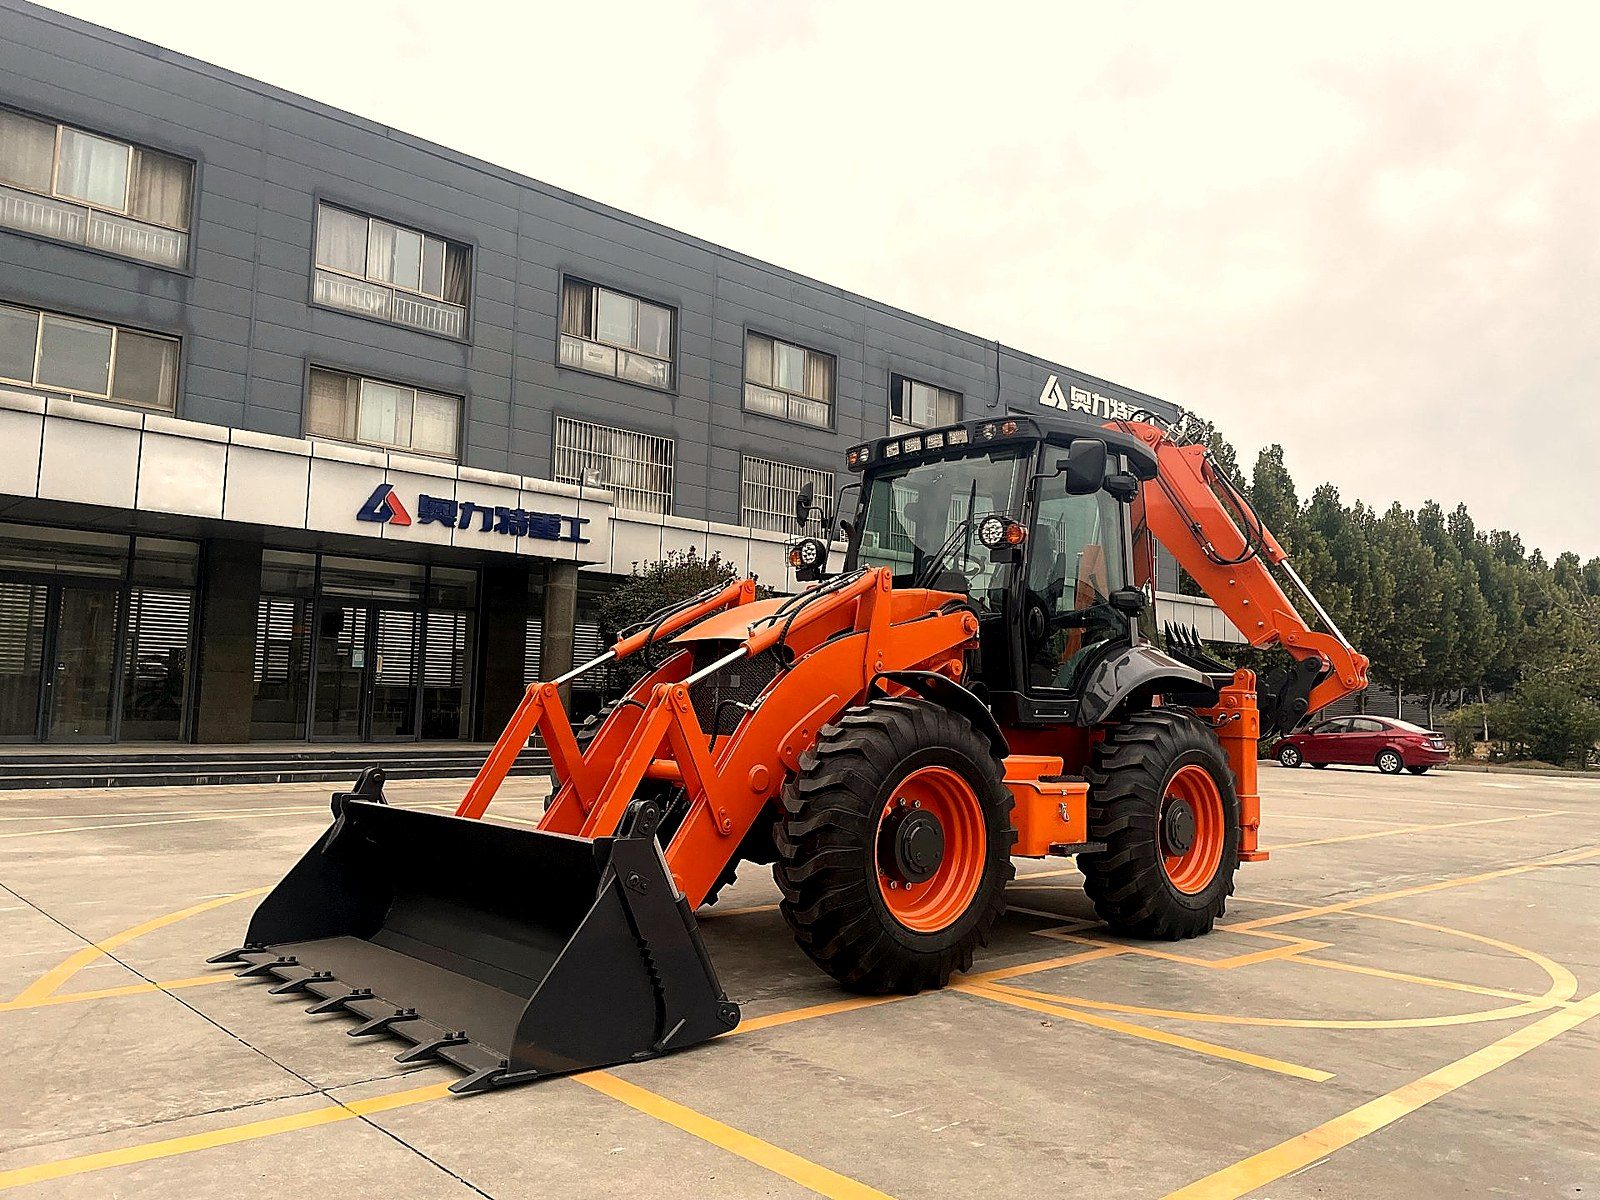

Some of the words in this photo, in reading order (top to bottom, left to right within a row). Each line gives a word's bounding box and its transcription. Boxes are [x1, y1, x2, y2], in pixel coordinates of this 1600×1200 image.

[417, 494, 590, 544] 奥力特重工
